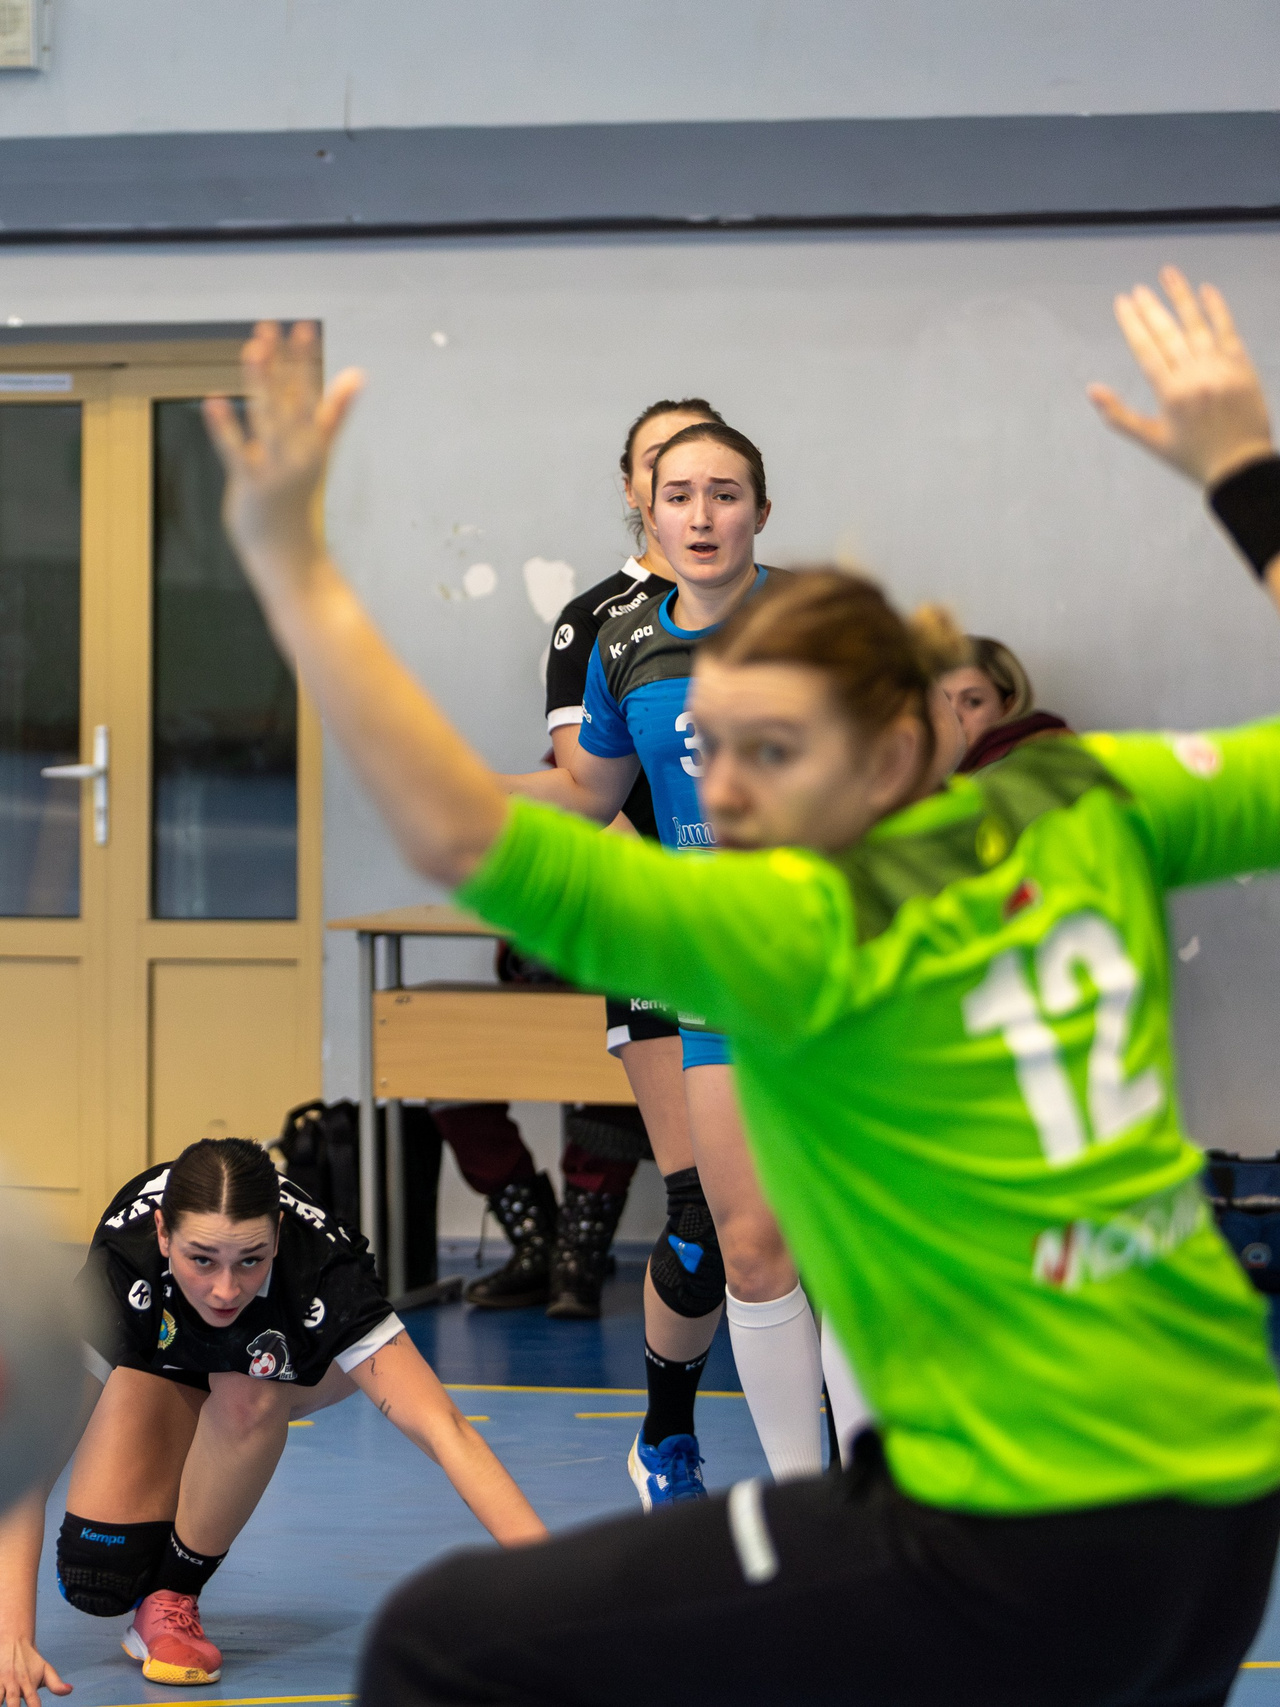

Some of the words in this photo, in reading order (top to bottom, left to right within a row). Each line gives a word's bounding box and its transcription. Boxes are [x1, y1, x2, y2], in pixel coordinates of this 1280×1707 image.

[609, 624, 654, 660] Kpa
[961, 911, 1163, 1167] 12
[80, 1527, 126, 1547] Kempa
[170, 1533, 204, 1566] mpa
